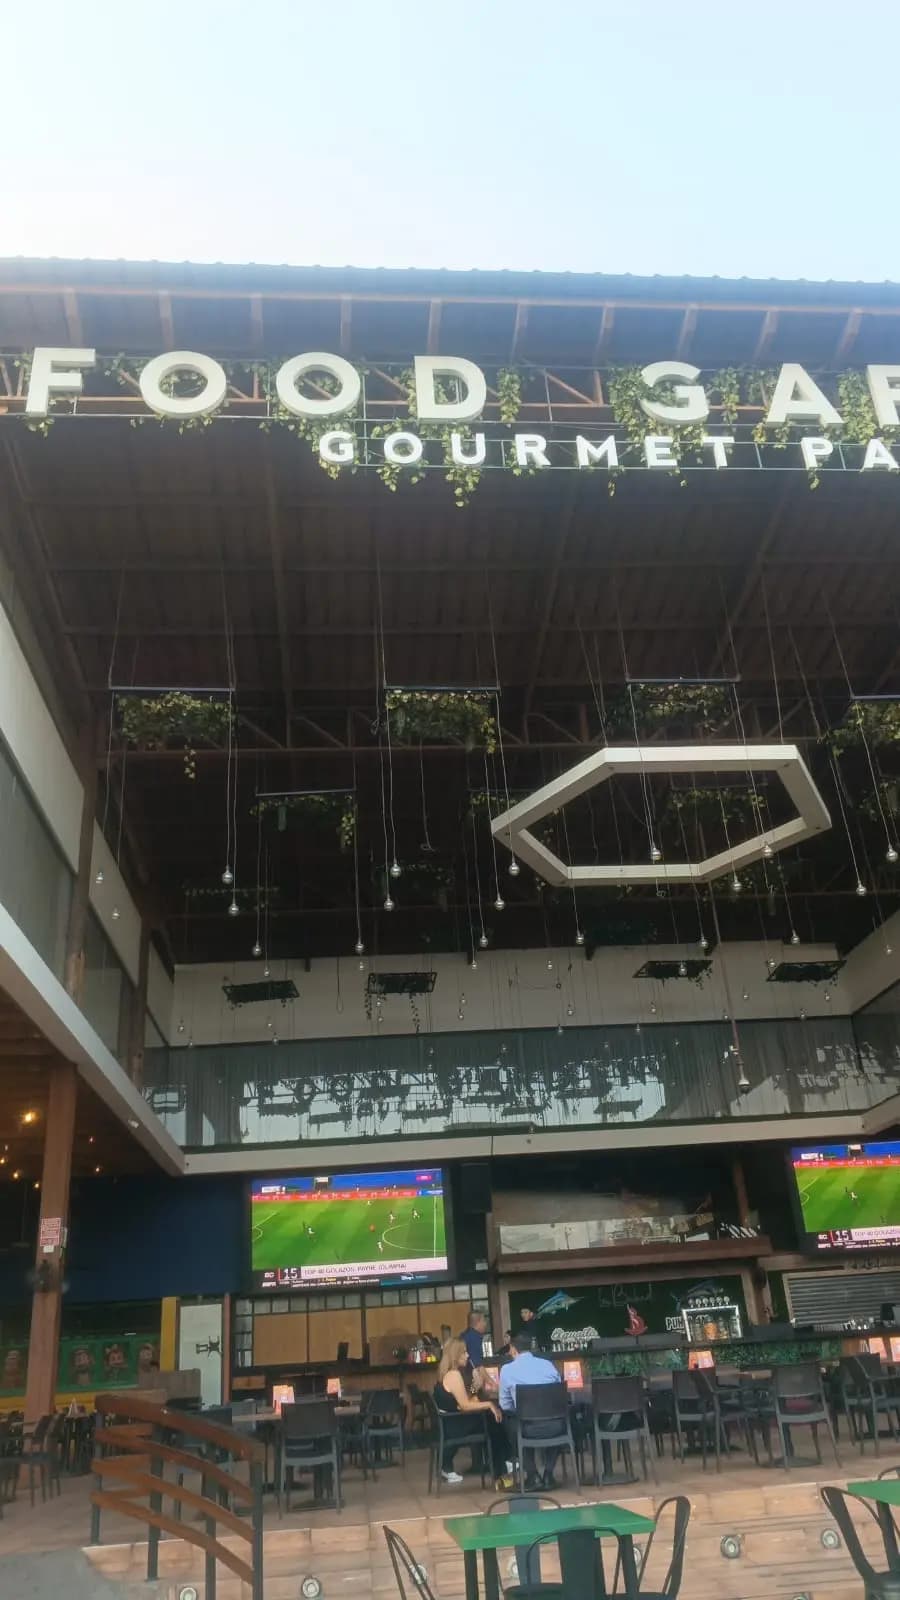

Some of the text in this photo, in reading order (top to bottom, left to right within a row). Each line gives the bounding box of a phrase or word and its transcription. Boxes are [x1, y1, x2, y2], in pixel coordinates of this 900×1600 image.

[25, 347, 487, 423] FOOD
[319, 431, 735, 470] GOURMET
[283, 1267, 298, 1280] 15
